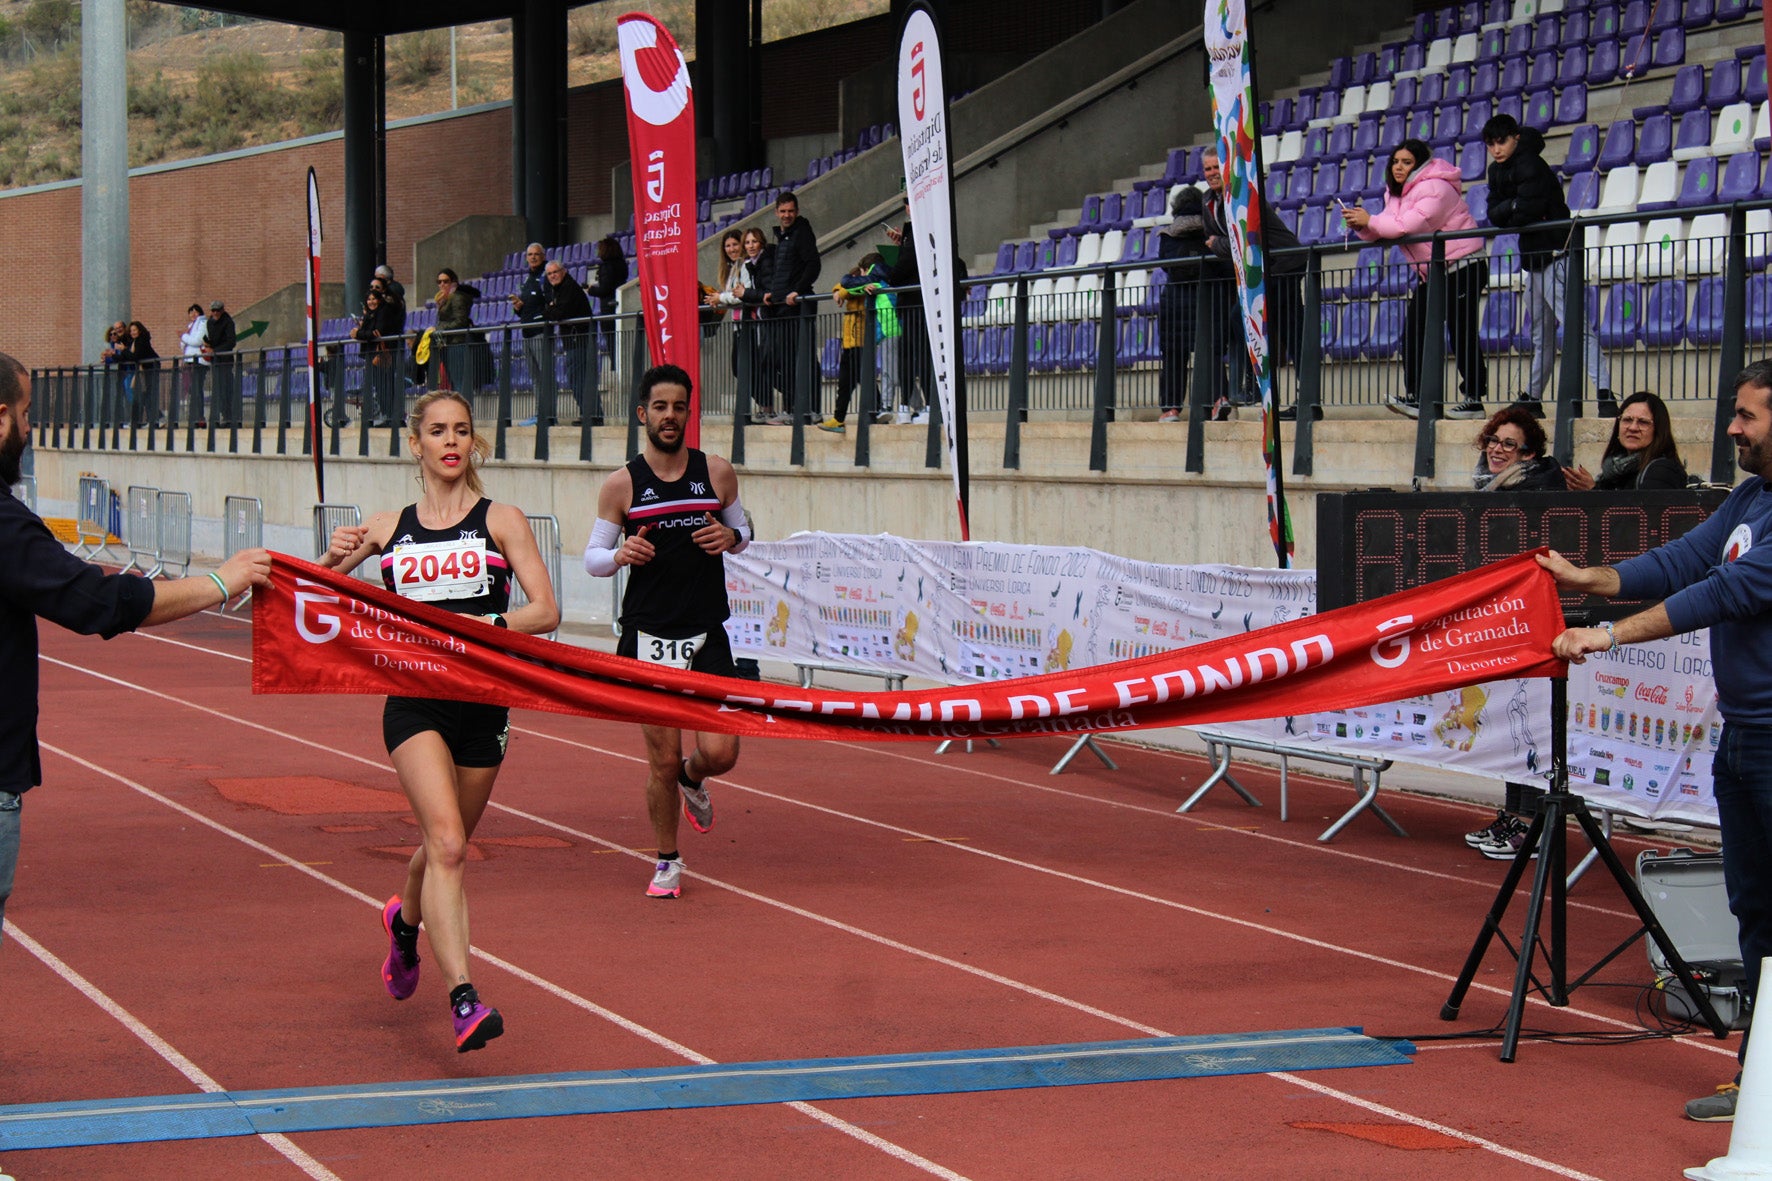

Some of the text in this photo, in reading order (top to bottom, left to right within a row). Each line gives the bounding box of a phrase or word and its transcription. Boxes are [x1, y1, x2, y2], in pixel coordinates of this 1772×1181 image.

[399, 550, 481, 584] 2049
[953, 540, 973, 571] GRAN
[976, 542, 1010, 574] PREMIO
[1012, 552, 1026, 574] DE
[1027, 549, 1061, 576] FONDO
[1060, 552, 1091, 578] 2023
[969, 577, 1005, 594] UNIVERSO
[1007, 578, 1032, 596] LORCA
[1184, 566, 1217, 594] FONDO
[1218, 569, 1253, 598] 2023
[350, 620, 467, 655] de Granada
[1420, 616, 1530, 653] de Granada
[373, 653, 448, 673] Deportes
[650, 639, 695, 661] 316
[1446, 653, 1518, 675] Deportes
[1673, 651, 1715, 677] LORC
[1007, 688, 1089, 720] DE
[1113, 633, 1335, 709] FONDO
[1595, 671, 1630, 687] Cruzcampo
